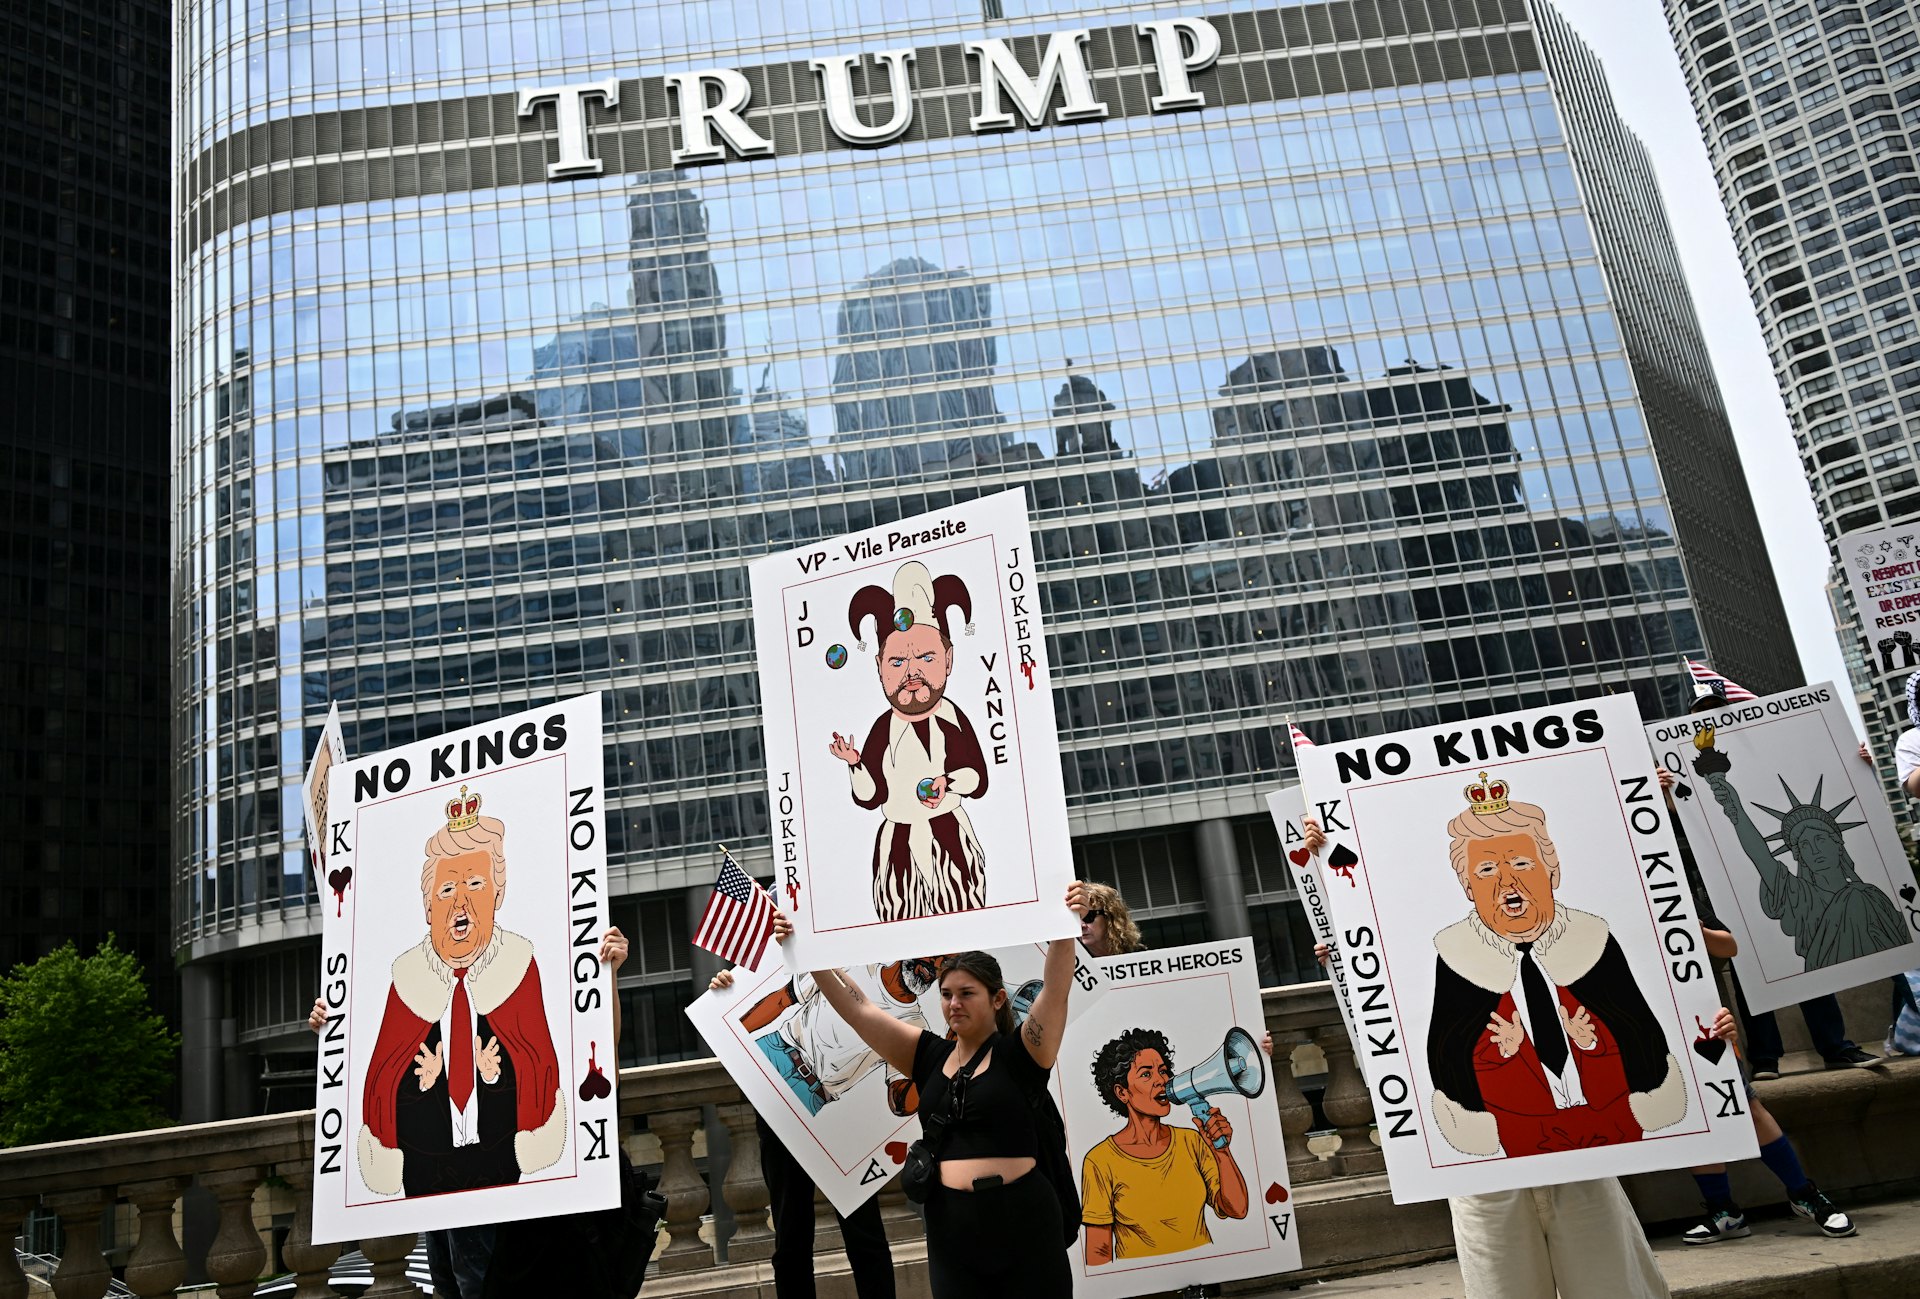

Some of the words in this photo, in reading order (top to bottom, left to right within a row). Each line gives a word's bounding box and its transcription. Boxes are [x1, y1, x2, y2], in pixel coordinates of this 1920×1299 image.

[518, 16, 1222, 181] TRUMP
[797, 551, 827, 575] VP
[844, 537, 883, 562] Vile
[888, 519, 967, 552] Parasite
[1872, 561, 1915, 582] RESPECT
[1878, 599, 1895, 612] OR
[981, 653, 1009, 765] VANCE
[1656, 724, 1691, 743] OUR
[1693, 706, 1763, 733] BELOVED
[1767, 689, 1830, 715] QUEENS
[355, 758, 411, 803] NO
[431, 714, 567, 783] KINGS
[1335, 743, 1411, 784] NO
[1433, 709, 1604, 768] KINGS
[1664, 751, 1688, 778] Q
[331, 820, 352, 856] K
[568, 786, 595, 851] NO
[1285, 819, 1305, 844] A
[1316, 799, 1351, 834] K
[1300, 873, 1333, 939] HEROES
[1620, 775, 1660, 835] NO
[1641, 851, 1704, 984] KINGS
[571, 868, 602, 1014] KINGS
[1167, 948, 1243, 973] HEROES
[1344, 926, 1400, 1058] KINGS
[322, 952, 348, 1090] KINGS
[1377, 1073, 1419, 1139] NO
[1705, 1079, 1745, 1118] K
[320, 1108, 342, 1175] NO
[580, 1119, 611, 1161] K
[860, 1158, 887, 1186] A
[1269, 1213, 1291, 1241] A
